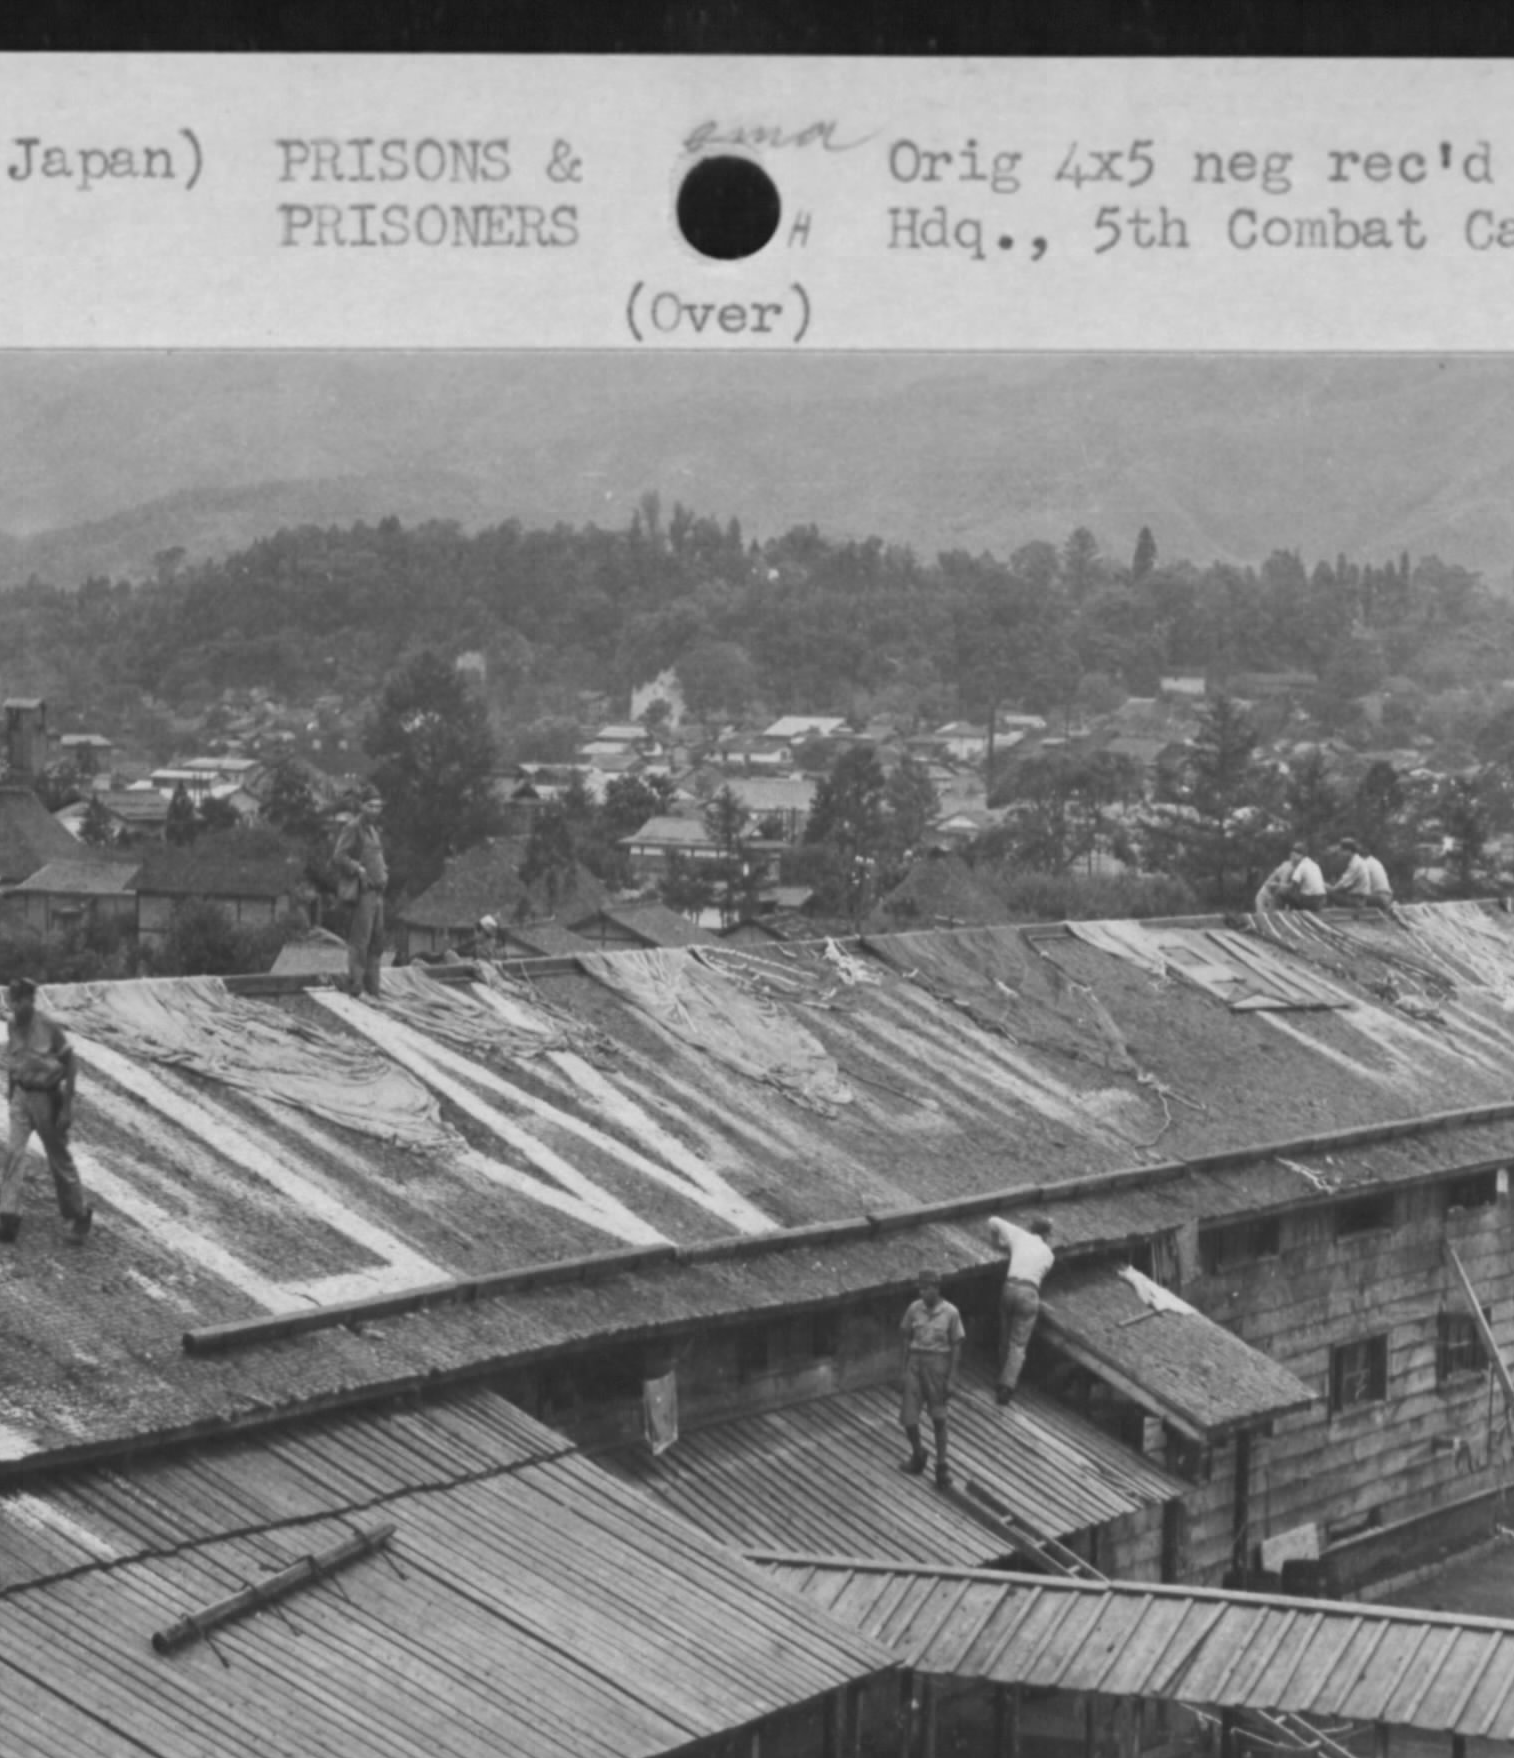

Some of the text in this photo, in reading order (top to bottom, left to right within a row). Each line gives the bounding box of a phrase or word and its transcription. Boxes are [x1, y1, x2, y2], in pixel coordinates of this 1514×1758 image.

[6, 126, 204, 191] Japan)
[275, 137, 584, 183] PRISONS &
[887, 138, 1022, 193] Orig
[1054, 139, 1155, 188] 4x5
[1192, 151, 1293, 194] neg
[1327, 140, 1493, 184] rec'd
[277, 203, 580, 248] PRISONERS
[887, 205, 1049, 262] Hdq.,
[1094, 205, 1190, 254] 5th
[1227, 207, 1427, 250] Combat
[625, 280, 811, 341] (Over)
